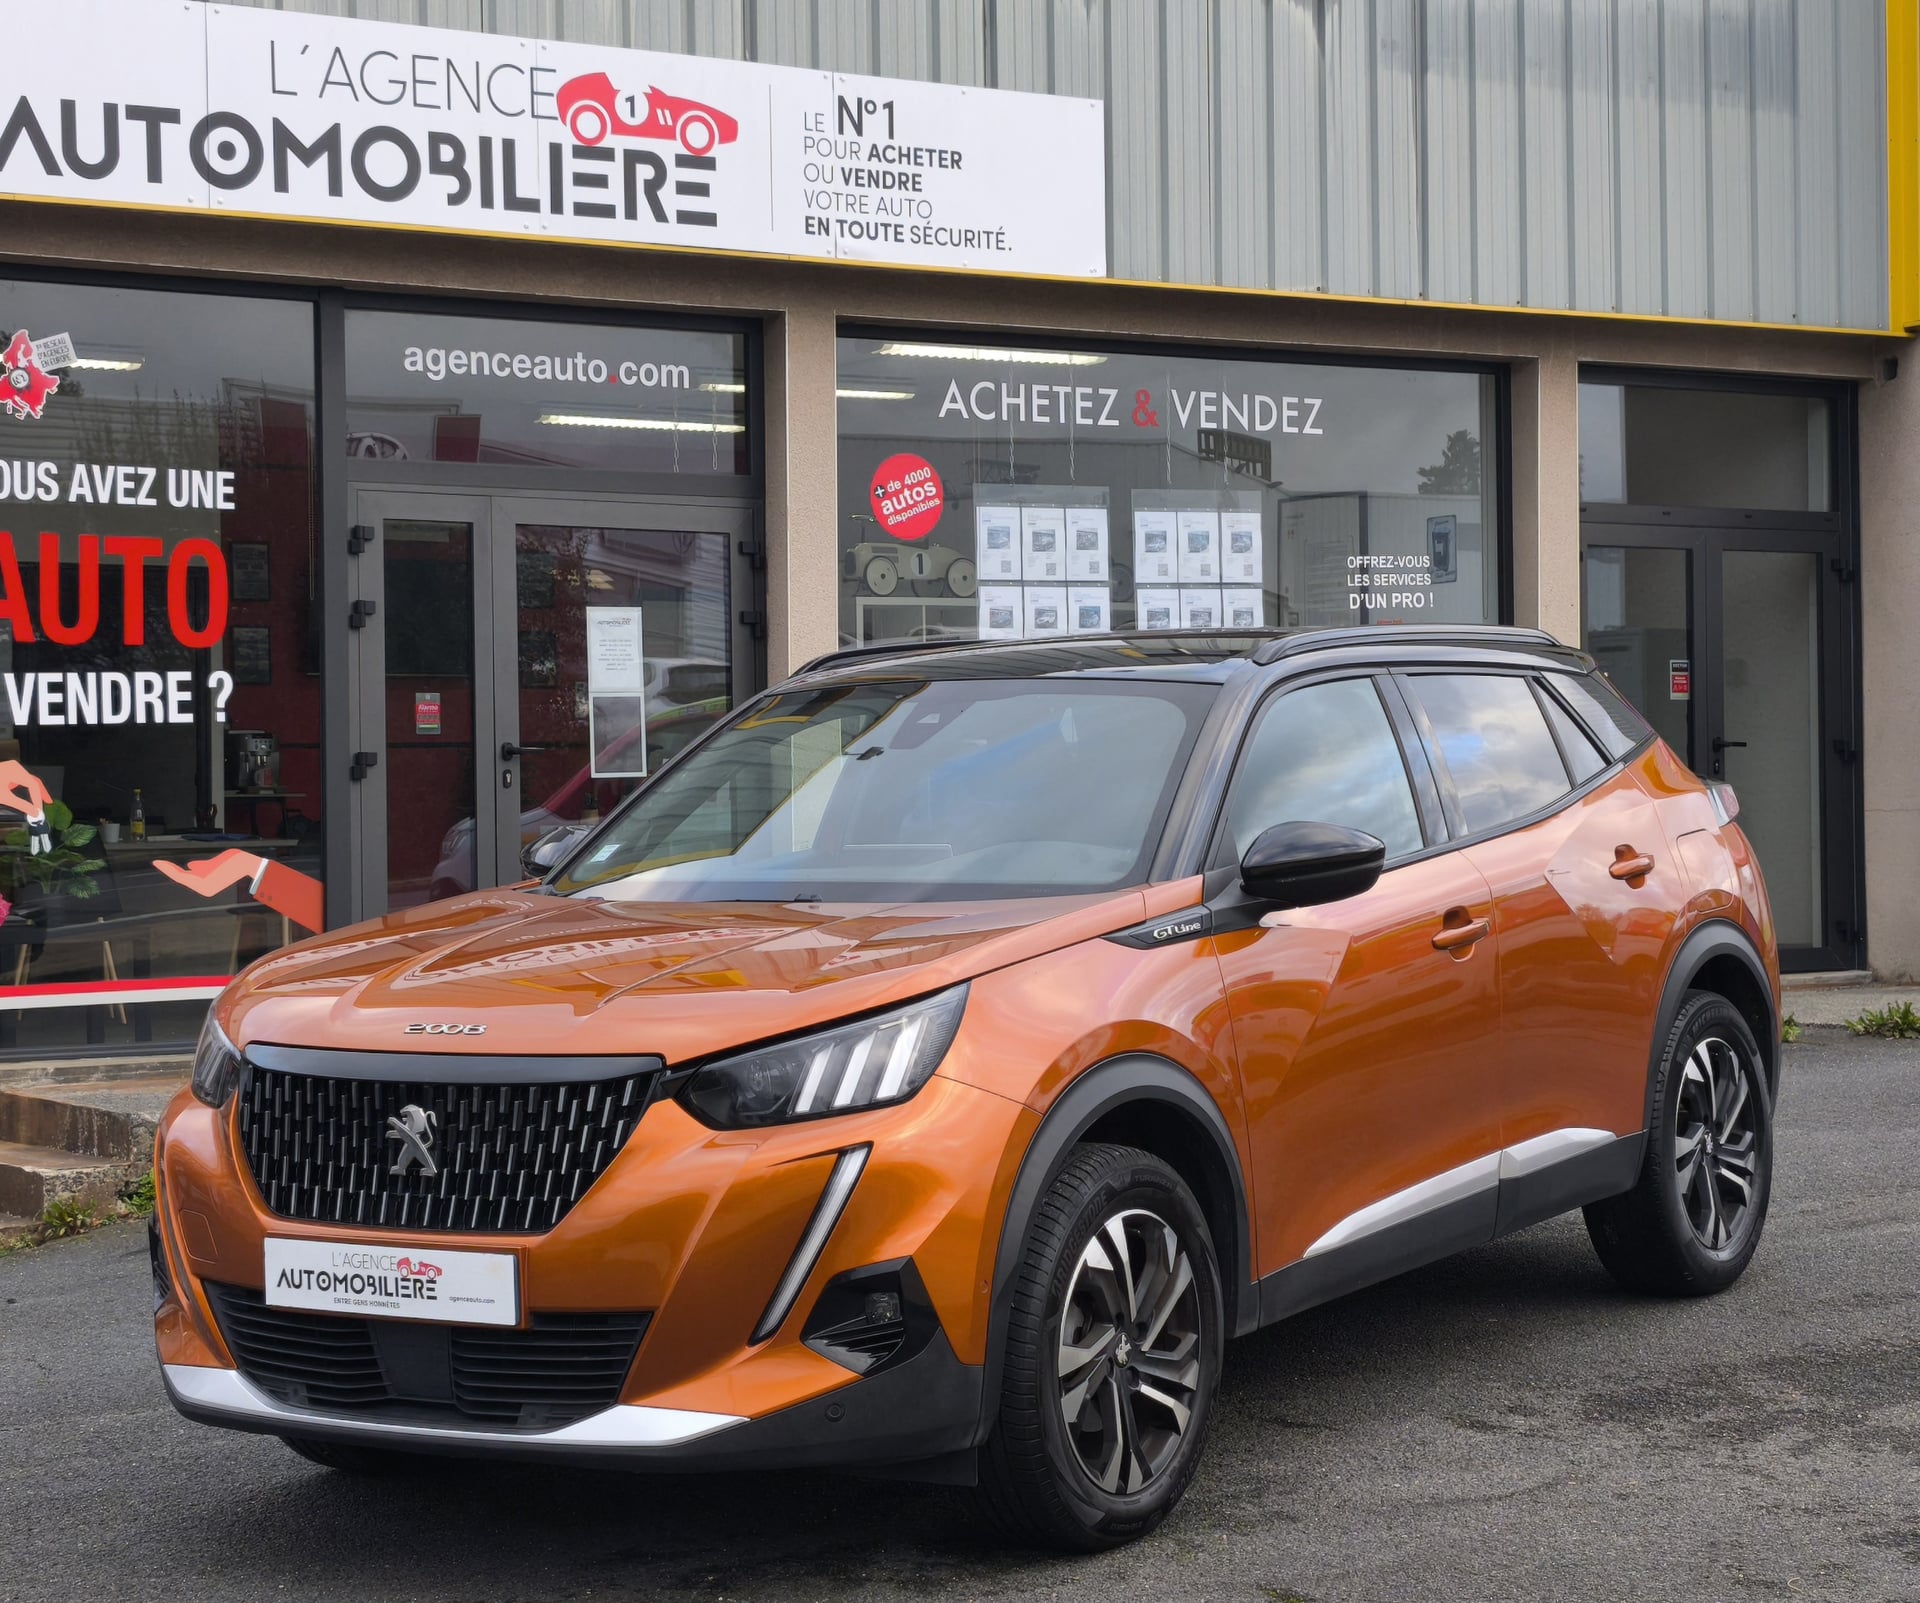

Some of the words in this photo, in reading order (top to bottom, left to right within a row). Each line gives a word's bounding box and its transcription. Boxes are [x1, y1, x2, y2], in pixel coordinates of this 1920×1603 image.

[270, 40, 558, 121] L'AGENCE
[625, 96, 636, 118] 1
[804, 111, 825, 133] LE
[804, 136, 861, 161] POUR
[867, 143, 962, 170] ACHETER
[804, 163, 834, 184] OU
[841, 166, 923, 192] VENDRE
[804, 188, 869, 214] VOTRE
[876, 196, 932, 219] AUTO
[805, 215, 830, 237] EN
[836, 219, 904, 243] TOUTE
[910, 220, 1012, 251] SÉCURITÉ.
[404, 346, 690, 389] agenceauto.com
[938, 378, 1119, 427] ACHETEZ
[1132, 389, 1158, 428] &
[1171, 389, 1323, 435] VENDEZ
[68, 463, 157, 506] AVEZ
[168, 468, 235, 510] UNE
[887, 480, 902, 492] de
[904, 467, 931, 485] 4000
[881, 481, 936, 515] autos
[887, 497, 941, 526] disponibles
[917, 553, 924, 575] 1
[1347, 555, 1431, 568] OFFREZ-VOUS
[1347, 574, 1370, 586] LES
[1373, 573, 1432, 586] SERVICES
[1349, 593, 1387, 609] D'UN
[1392, 592, 1425, 608] PRO
[3, 671, 194, 726] VENDRE
[208, 670, 234, 723] ?
[404, 1023, 487, 1036] 2008
[331, 1251, 398, 1272] L'AGENCE
[333, 1297, 352, 1306] ENTRE
[353, 1298, 369, 1307] GENS
